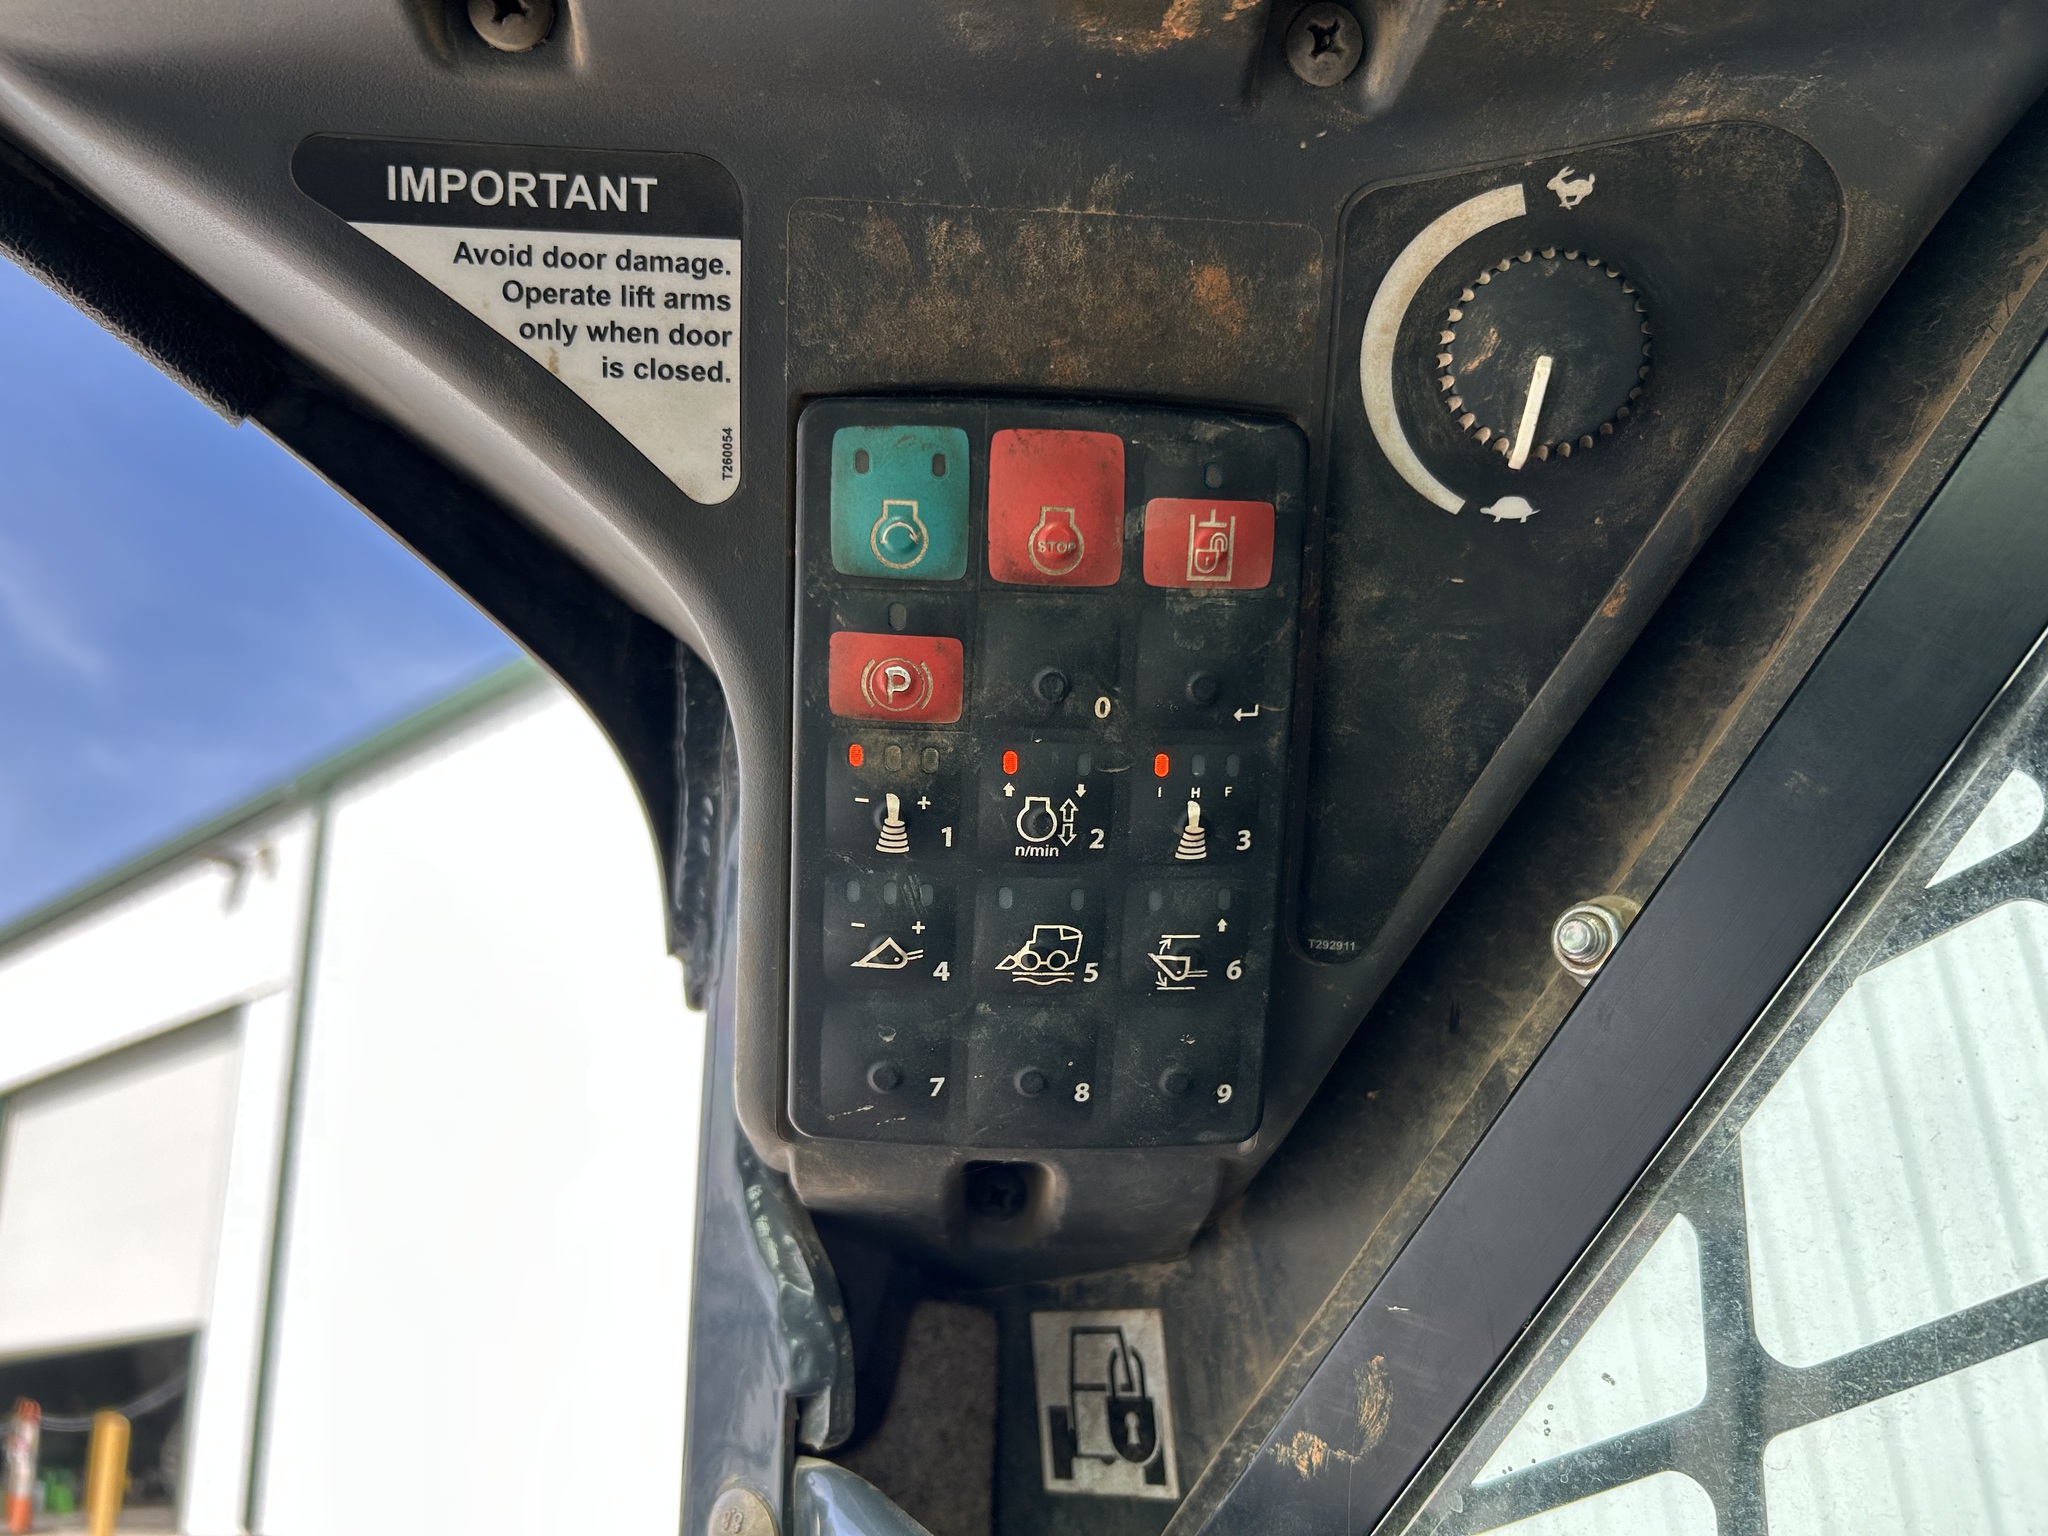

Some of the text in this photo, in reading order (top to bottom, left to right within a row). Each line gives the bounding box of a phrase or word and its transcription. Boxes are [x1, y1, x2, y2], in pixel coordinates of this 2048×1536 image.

[386, 164, 659, 214] IMPORTANT
[452, 241, 732, 280] Avoid door damage.
[501, 279, 732, 312] Operate lift arms
[518, 319, 733, 347] only when door
[601, 355, 731, 384] is closed.
[721, 427, 733, 481] T260054
[1037, 540, 1077, 554] STOP
[884, 665, 912, 704] P
[1094, 696, 1111, 719] 0
[1190, 787, 1201, 799] H
[1224, 786, 1233, 798] F
[941, 826, 952, 848] 1
[1089, 828, 1105, 849] 2
[1236, 829, 1251, 851] 3
[1015, 844, 1060, 857] n/min
[1307, 938, 1356, 951] T292911
[932, 961, 951, 982] 4
[1083, 962, 1099, 983] 5
[1226, 960, 1242, 980] 6
[929, 1076, 946, 1097] 7
[1073, 1082, 1090, 1102] 8
[1216, 1084, 1233, 1104] 9
